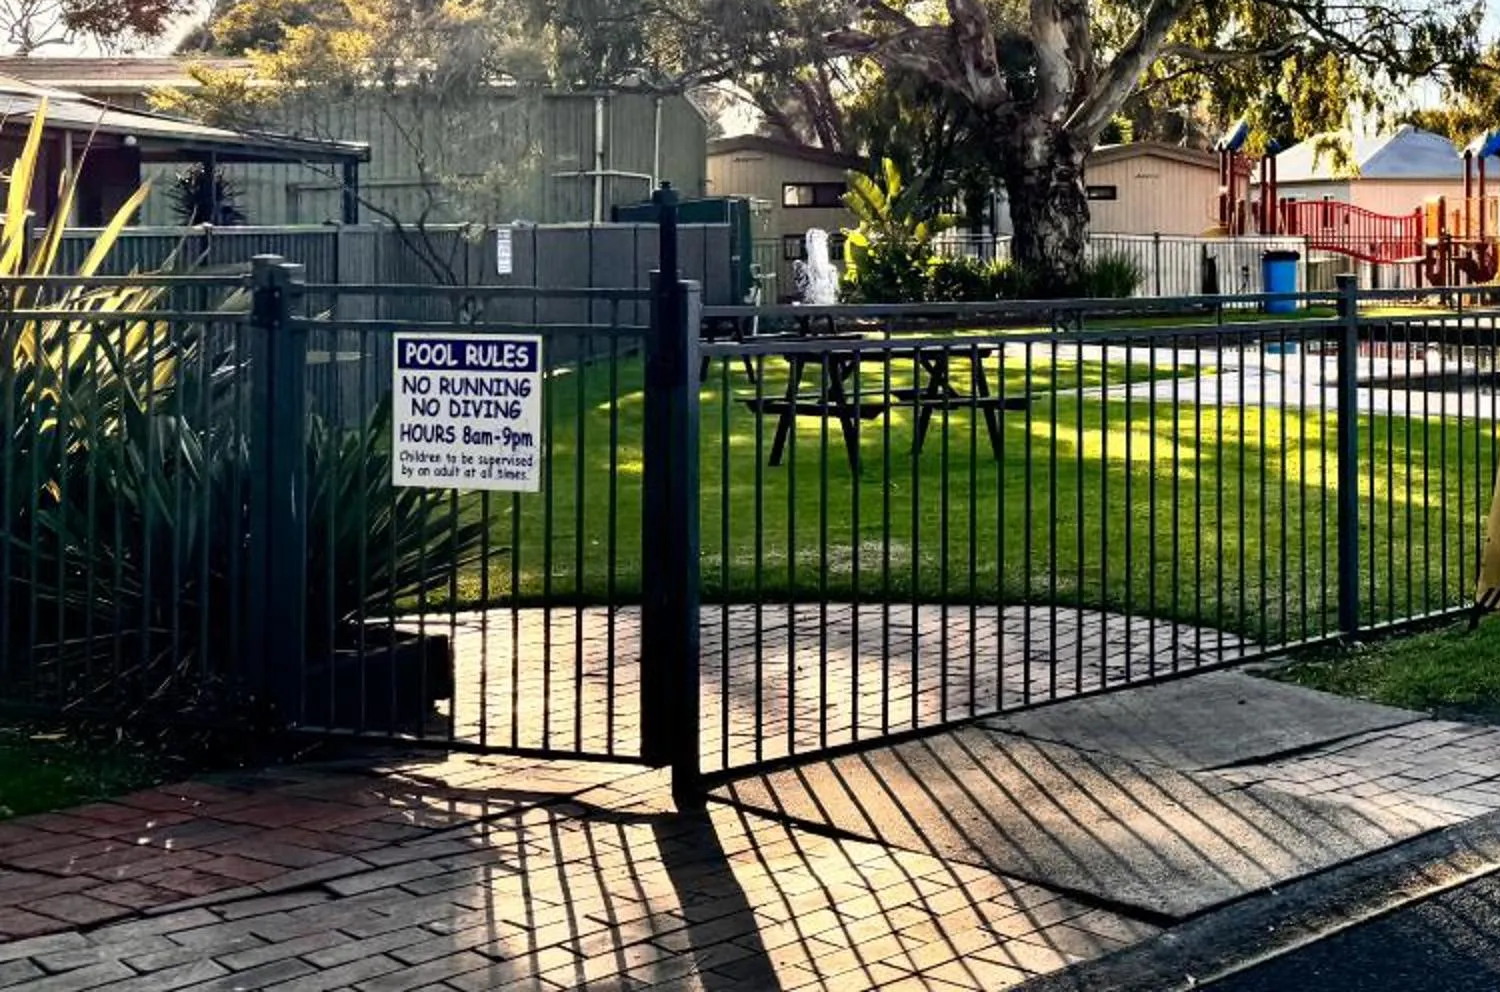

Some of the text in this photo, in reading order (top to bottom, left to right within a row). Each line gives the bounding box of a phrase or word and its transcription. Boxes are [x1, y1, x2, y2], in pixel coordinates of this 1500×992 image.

[405, 342, 529, 368] POOL RULES
[402, 376, 532, 398] NO RUNNING
[411, 398, 521, 419] NO DIVING
[401, 423, 533, 451] HOURS 8am-9pm
[400, 450, 533, 469] Children to be supervised
[401, 464, 413, 478] by
[417, 467, 431, 477] an
[433, 465, 460, 477] adult
[463, 468, 477, 478] at
[480, 467, 493, 479] all
